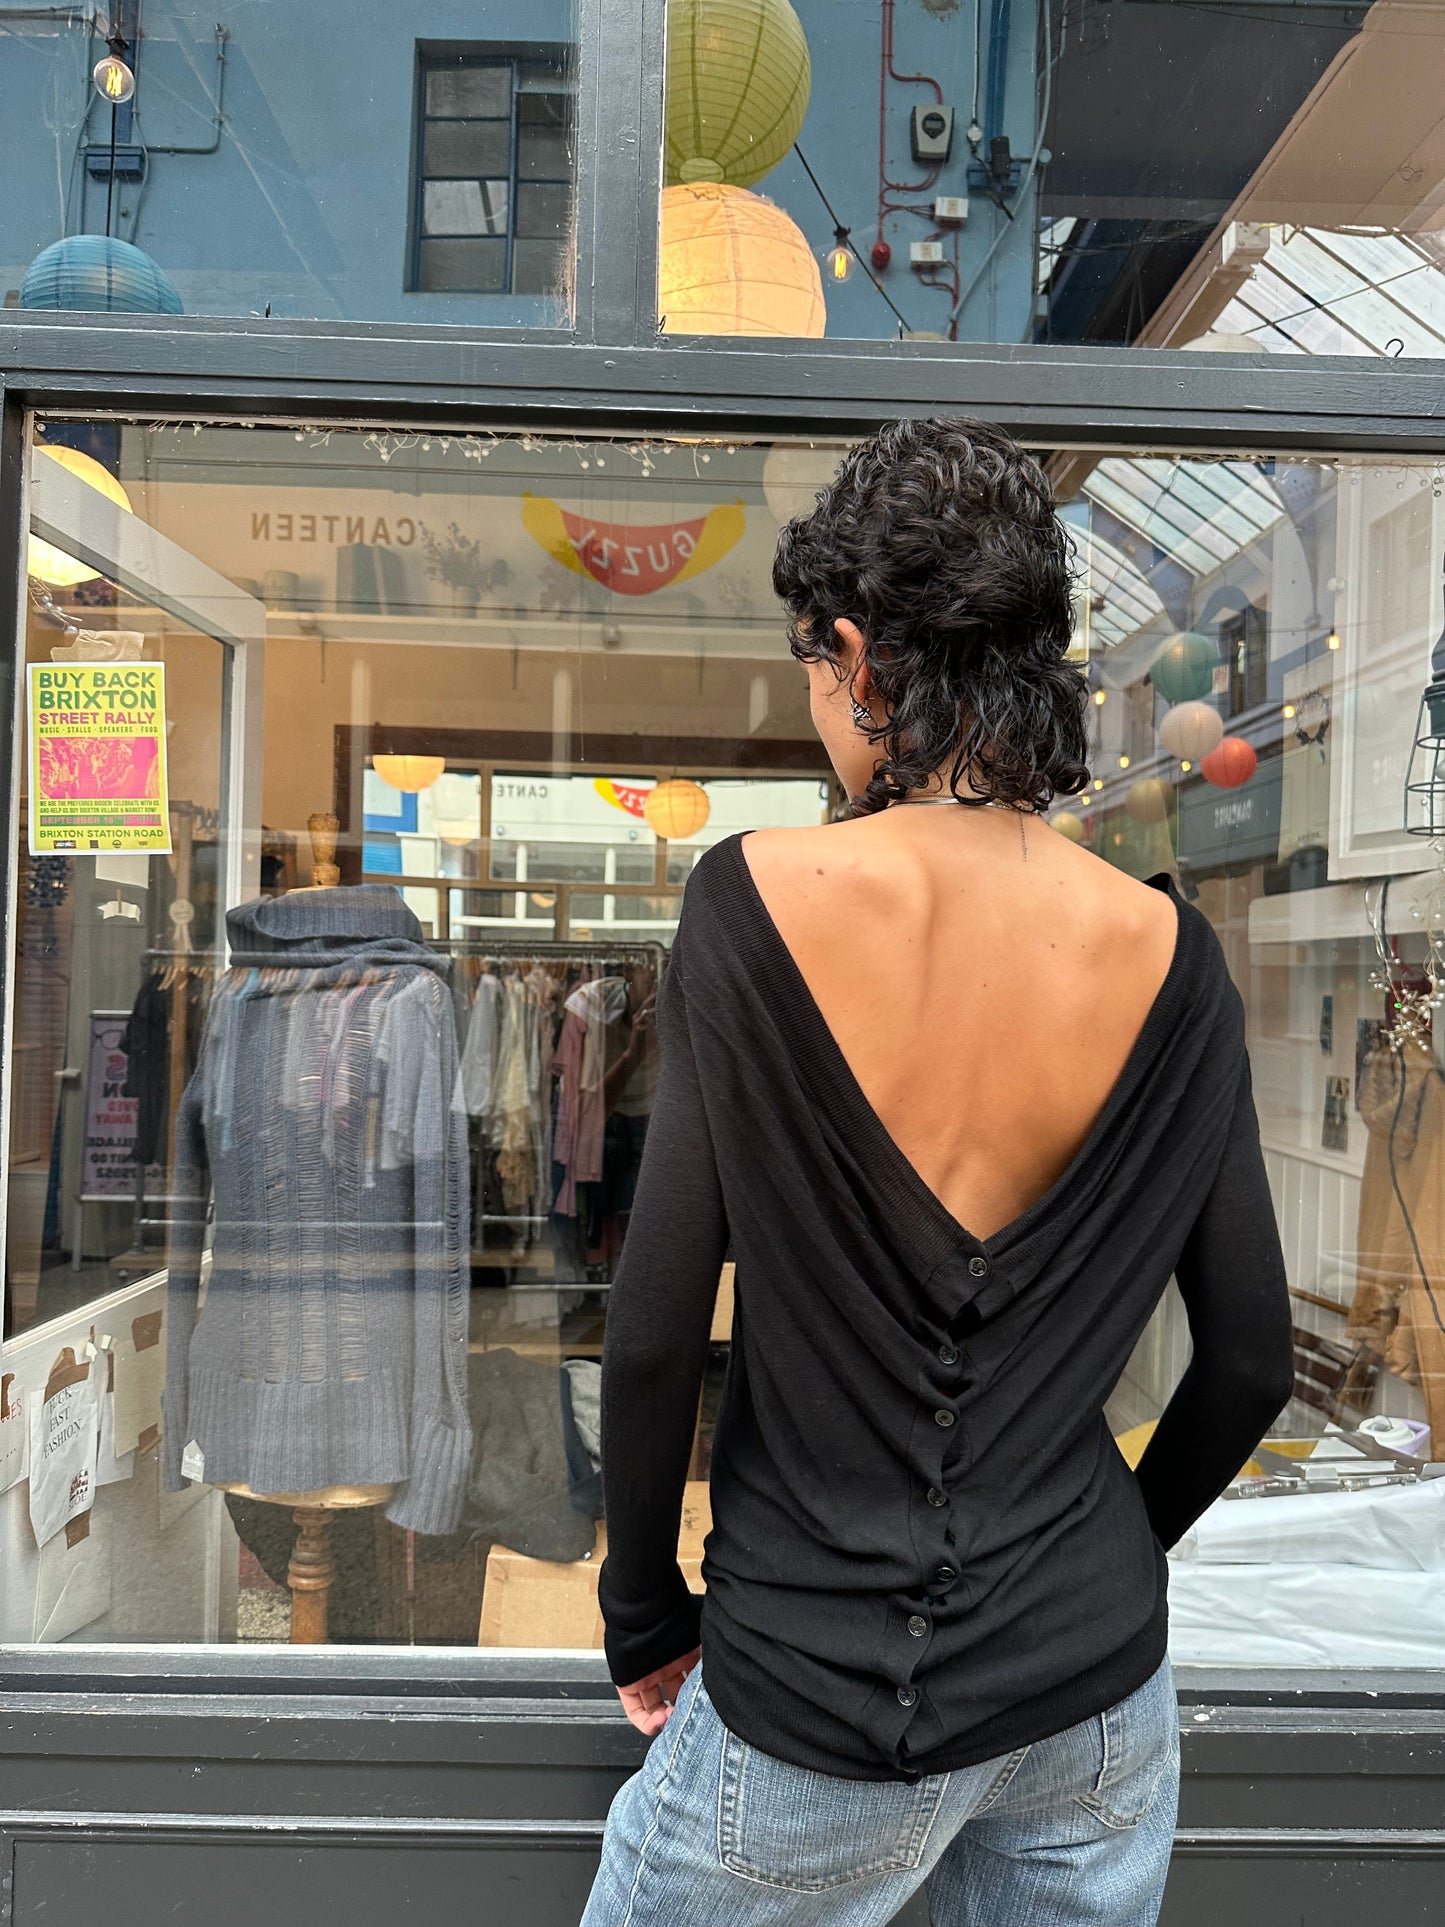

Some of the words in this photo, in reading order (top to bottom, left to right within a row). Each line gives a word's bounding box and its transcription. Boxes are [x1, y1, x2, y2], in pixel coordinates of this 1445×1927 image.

[39, 672, 85, 688] BUY
[93, 671, 156, 688] BACK
[39, 689, 157, 709] BRIXTON
[39, 712, 99, 724] STREET
[104, 712, 155, 724] RALLY
[41, 816, 100, 825] SEPTEMBER
[40, 829, 84, 838] BRIXTON
[87, 829, 131, 838] STATION
[134, 829, 164, 838] ROAD
[49, 1406, 71, 1433] FAST
[43, 1418, 82, 1460] FASHION
